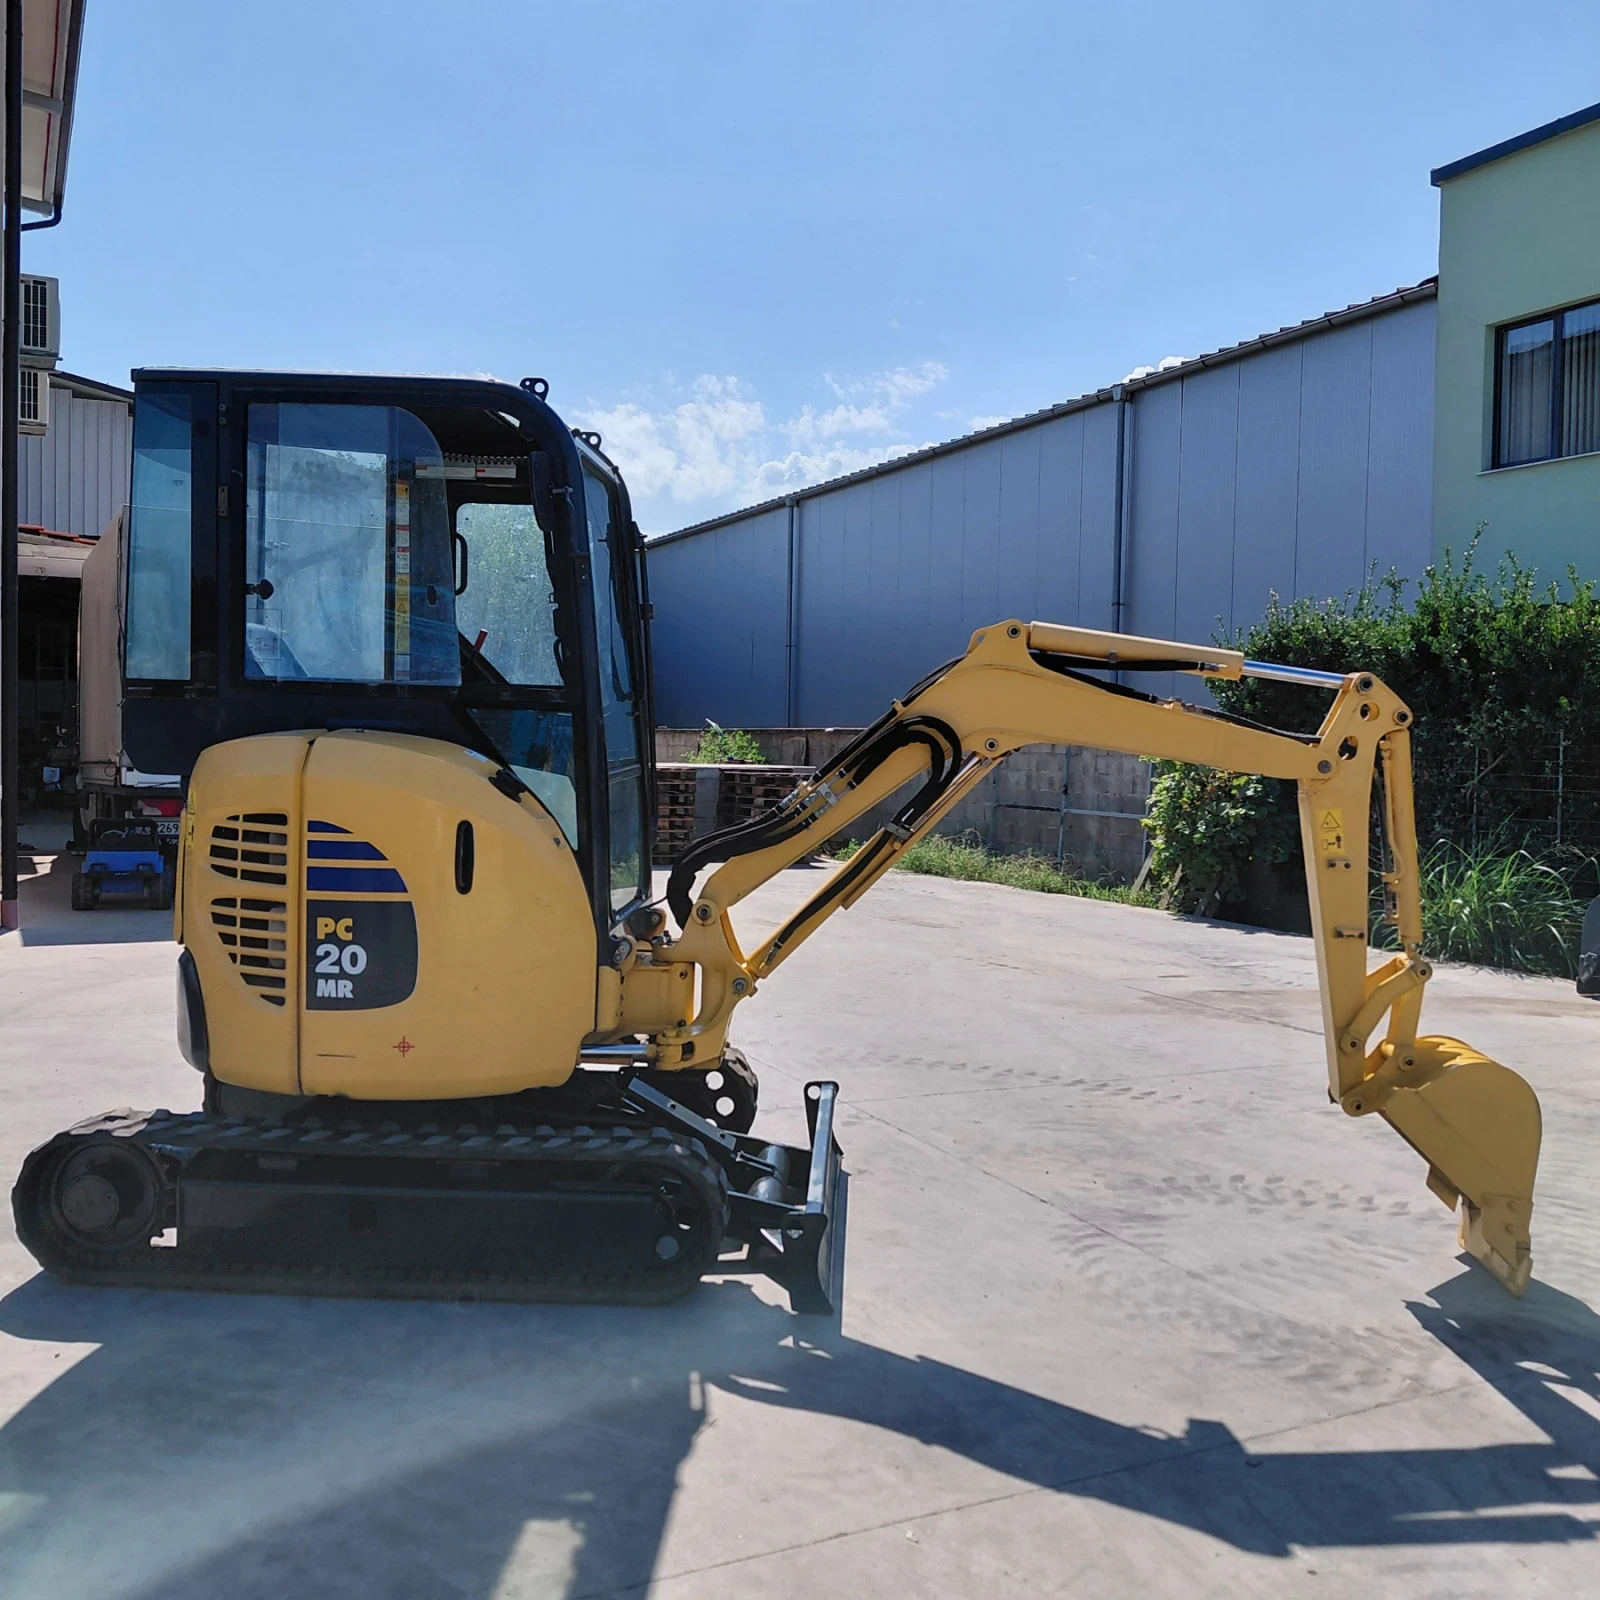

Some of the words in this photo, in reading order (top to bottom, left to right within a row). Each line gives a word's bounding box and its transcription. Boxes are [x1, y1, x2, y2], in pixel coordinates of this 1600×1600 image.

[157, 823, 179, 834] 269
[316, 917, 353, 941] PC
[315, 943, 367, 975] 20
[316, 978, 354, 998] MR
